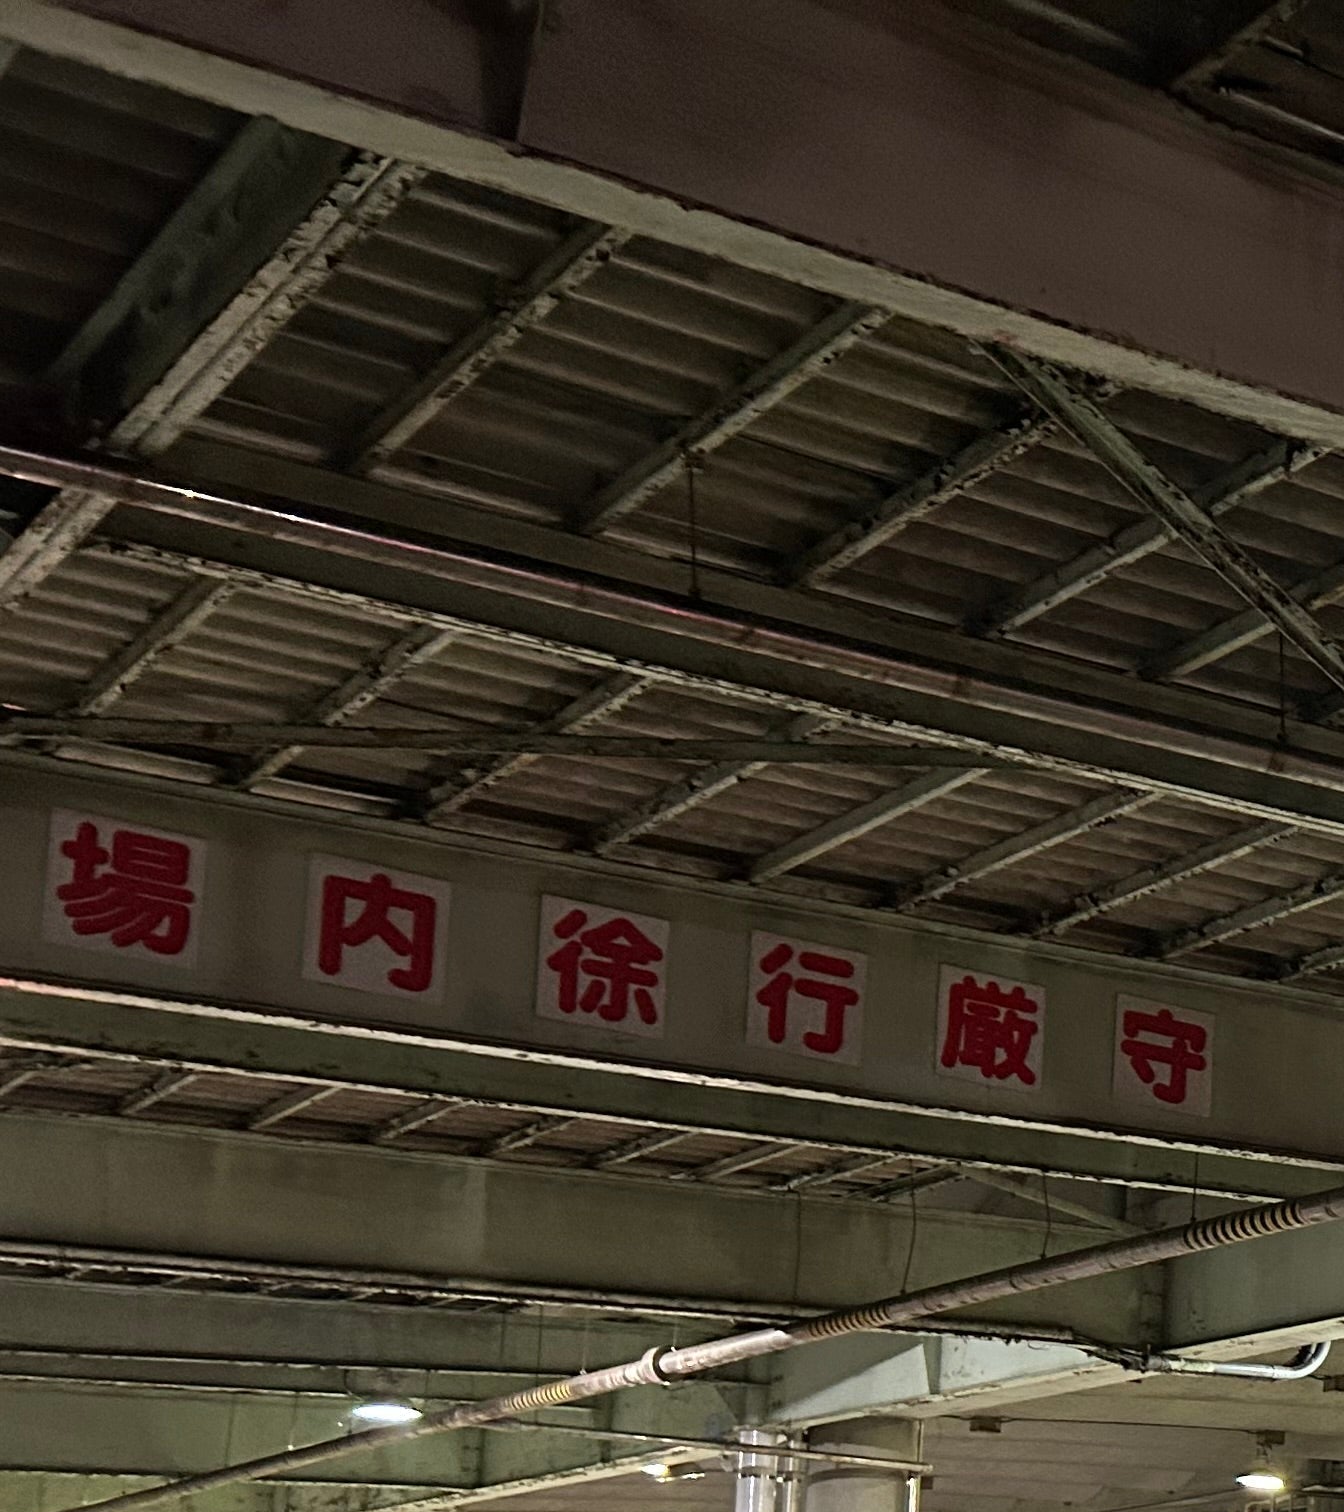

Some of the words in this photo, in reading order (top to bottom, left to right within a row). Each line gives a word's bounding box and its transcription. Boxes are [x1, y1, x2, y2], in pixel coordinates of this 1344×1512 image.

[56, 821, 1209, 1105] 場内徐行厳守
